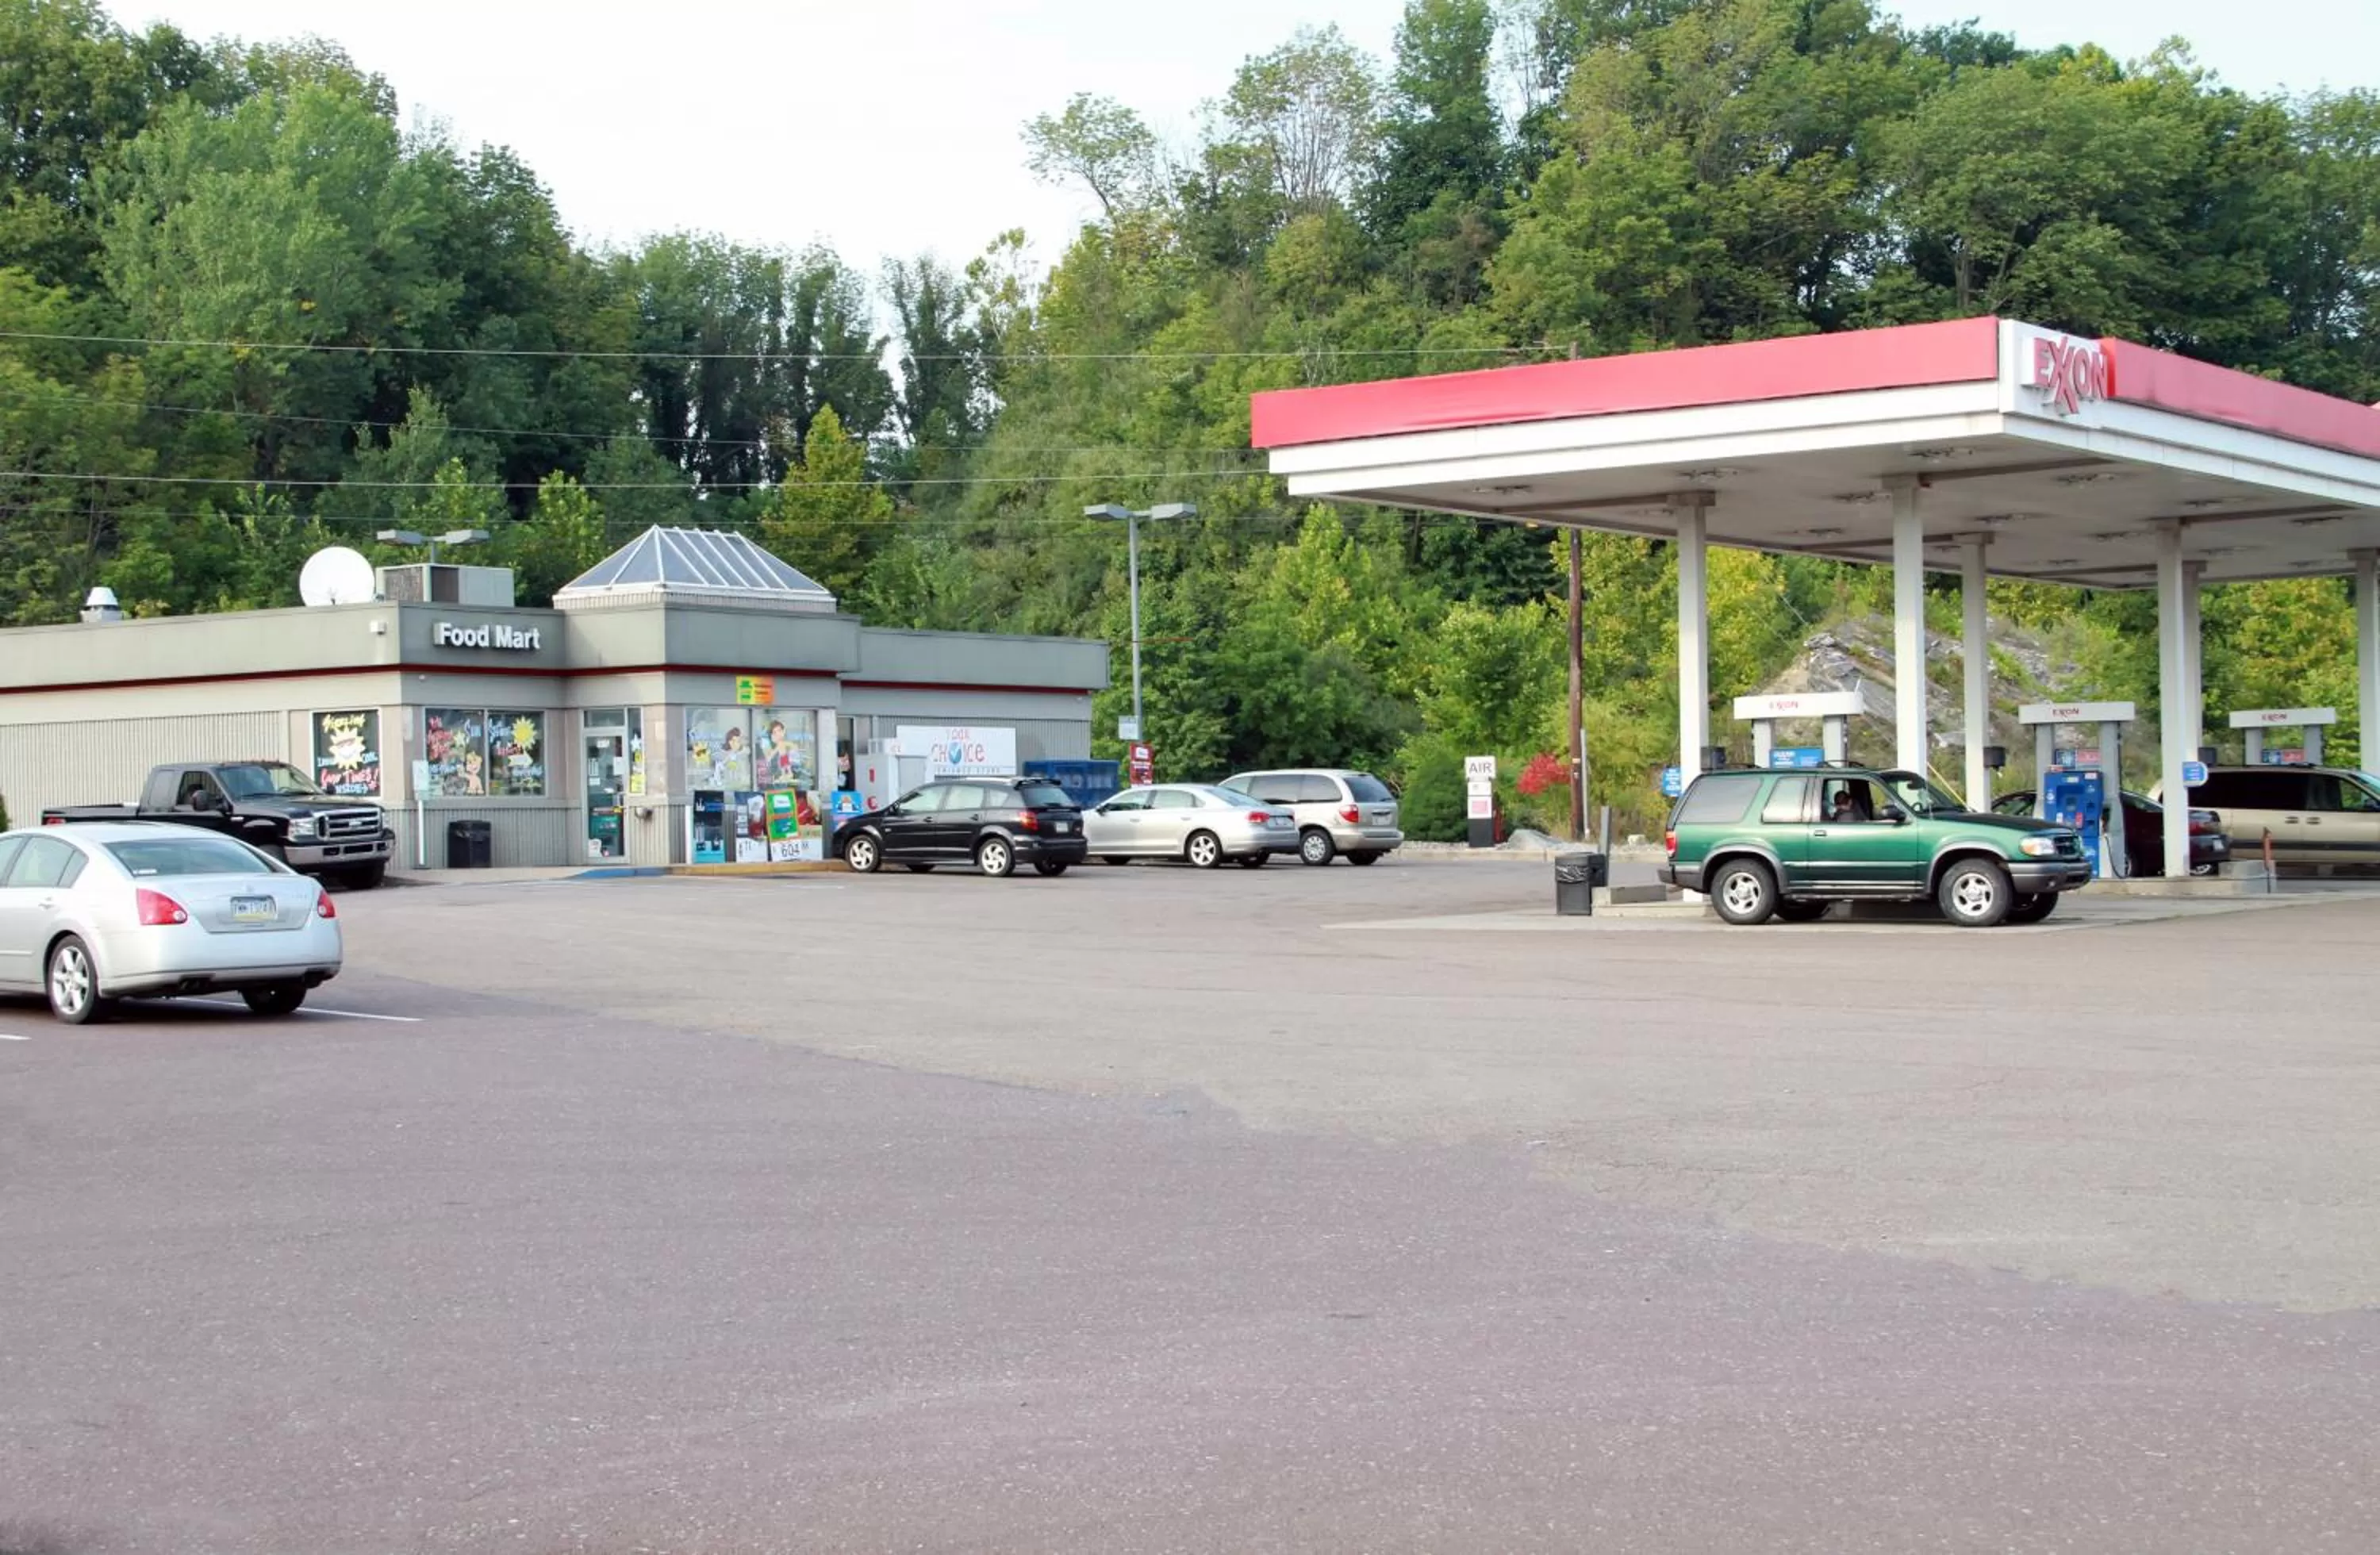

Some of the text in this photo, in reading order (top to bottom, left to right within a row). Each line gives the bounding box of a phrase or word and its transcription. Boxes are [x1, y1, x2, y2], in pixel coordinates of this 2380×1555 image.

[2033, 336, 2108, 414] EXXON
[435, 622, 540, 649] Food Mart
[1468, 762, 1492, 774] AIR
